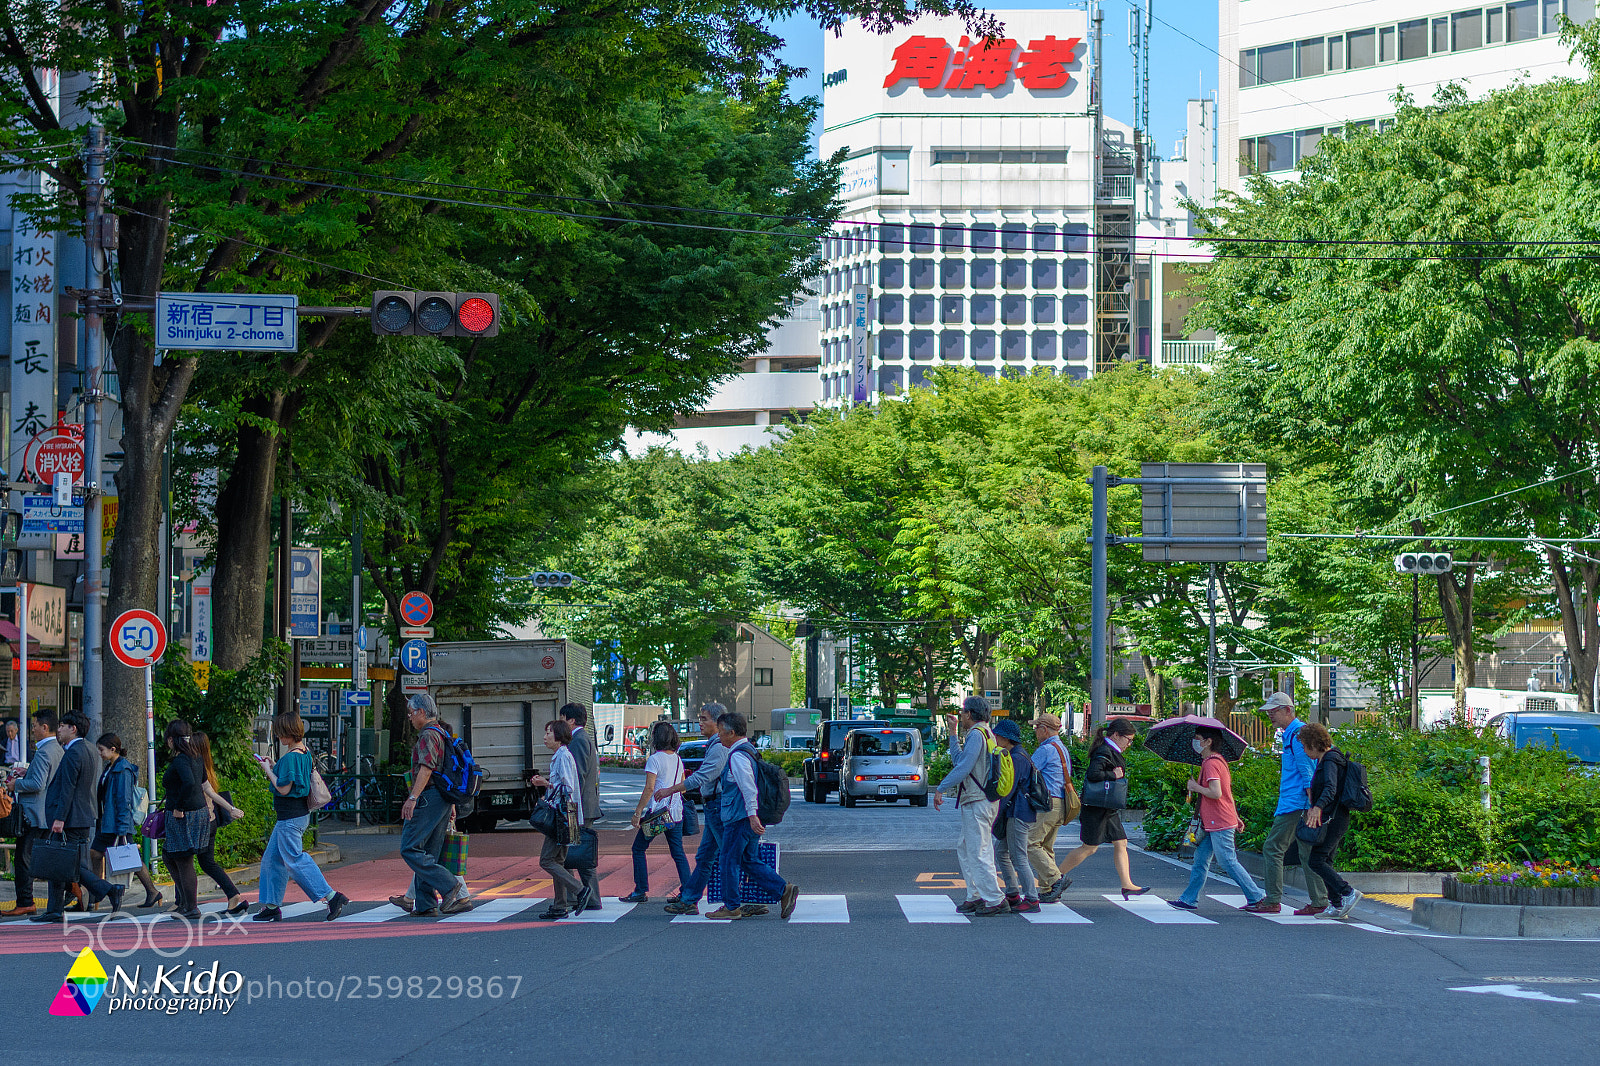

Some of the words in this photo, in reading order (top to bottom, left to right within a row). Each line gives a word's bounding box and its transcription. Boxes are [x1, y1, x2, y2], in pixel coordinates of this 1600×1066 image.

[883, 35, 1082, 89] 角海老
[167, 302, 284, 326] 新宿二丁目
[167, 326, 222, 341] Shinjuku
[227, 327, 285, 341] 2-chome
[39, 452, 82, 472] 消火栓
[291, 556, 312, 589] P
[123, 626, 154, 651] 50
[408, 647, 421, 668] P
[417, 659, 427, 668] 40
